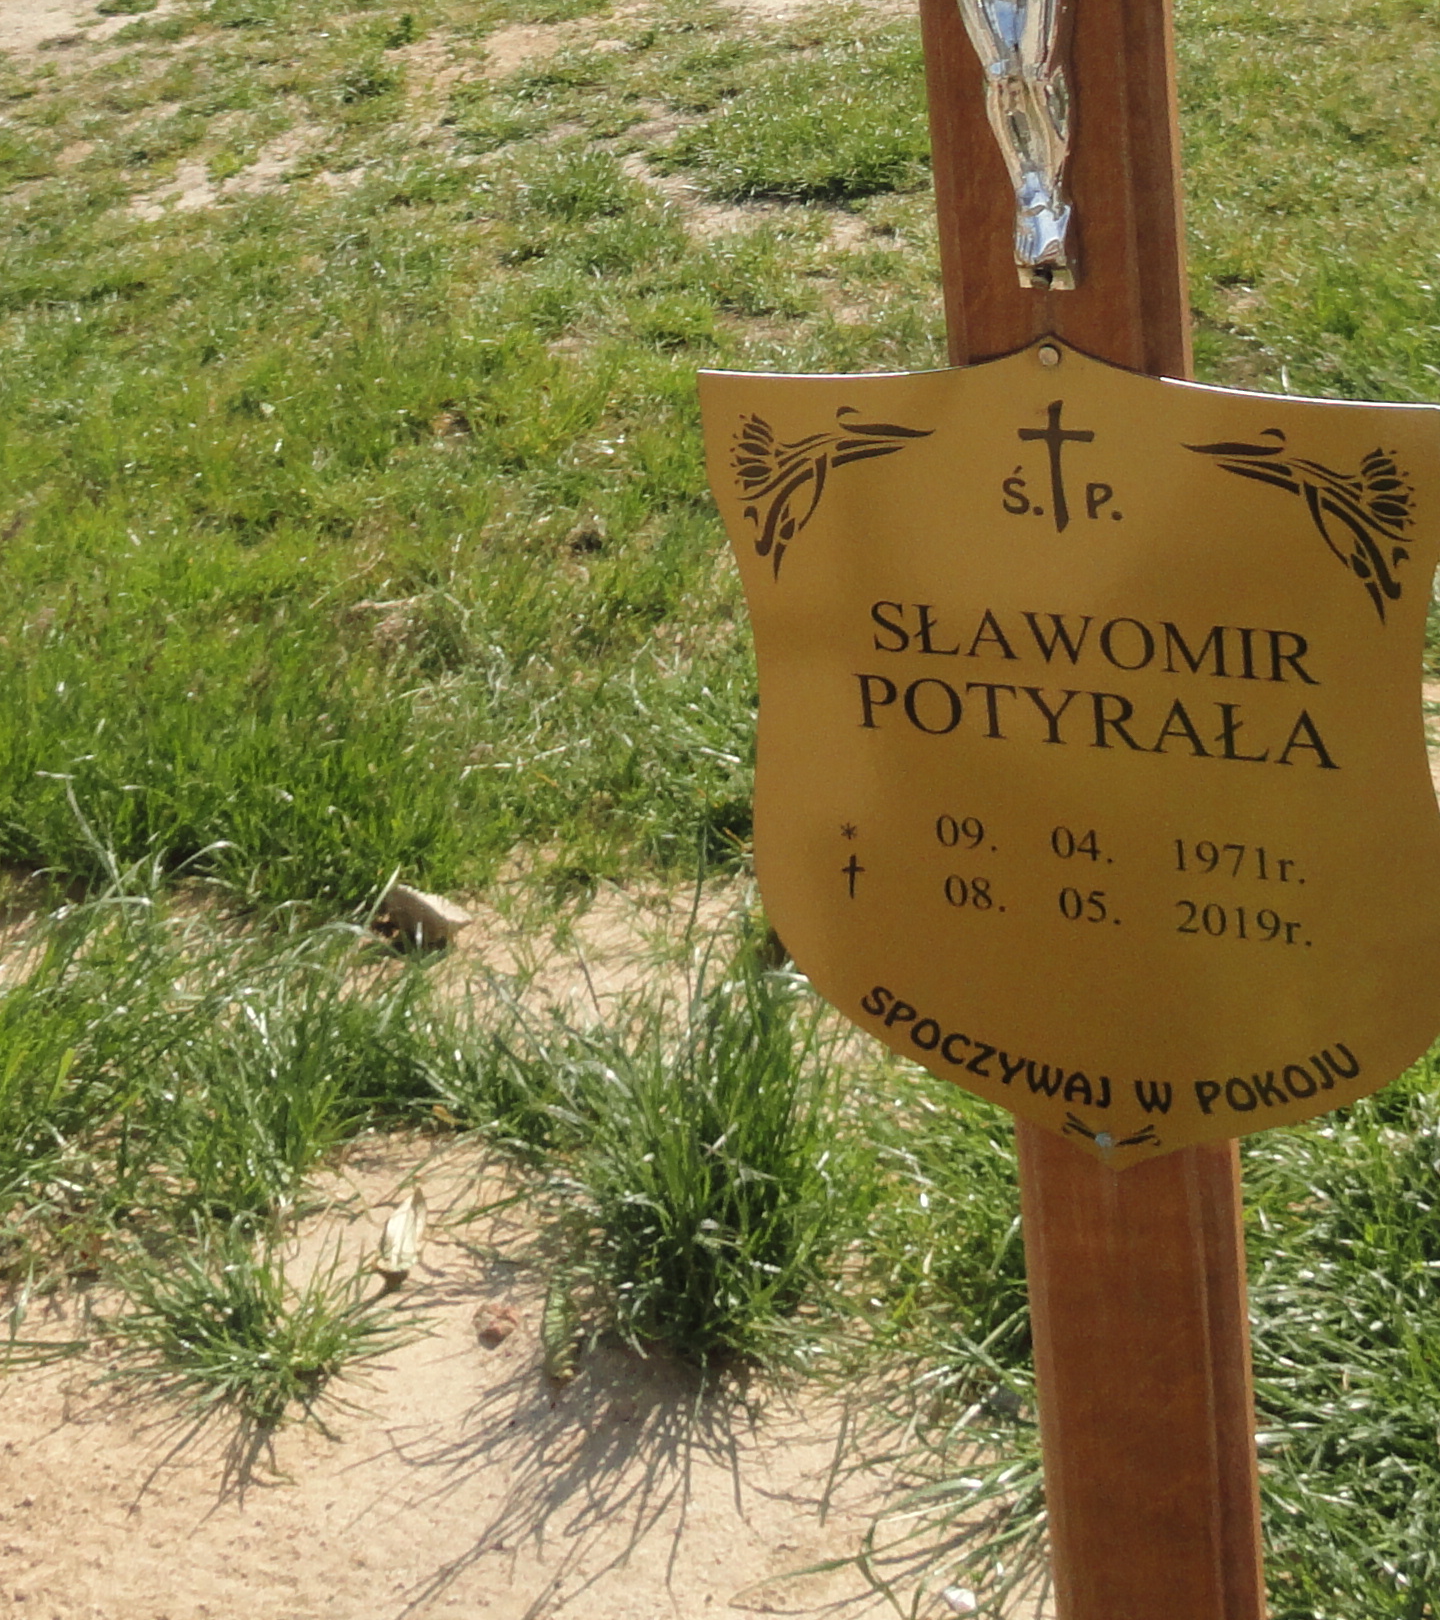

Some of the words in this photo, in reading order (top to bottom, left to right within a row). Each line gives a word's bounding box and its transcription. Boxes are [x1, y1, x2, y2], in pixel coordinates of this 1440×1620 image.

[1003, 466, 1043, 516] Ś.
[1086, 483, 1122, 520] P.
[871, 601, 1321, 685] SŁAWOMIR
[855, 674, 1341, 770] POTYRAŁA
[937, 815, 997, 851] 09.
[1052, 827, 1112, 864] 04.
[1175, 839, 1305, 884] 1971r.
[944, 876, 1005, 912] 08.
[1059, 888, 1120, 925] 05.
[1176, 900, 1311, 946] 2019r.
[861, 986, 1112, 1109] SPOCZYWAJ
[1135, 1079, 1172, 1114] W
[1194, 1043, 1360, 1118] POKOJU
